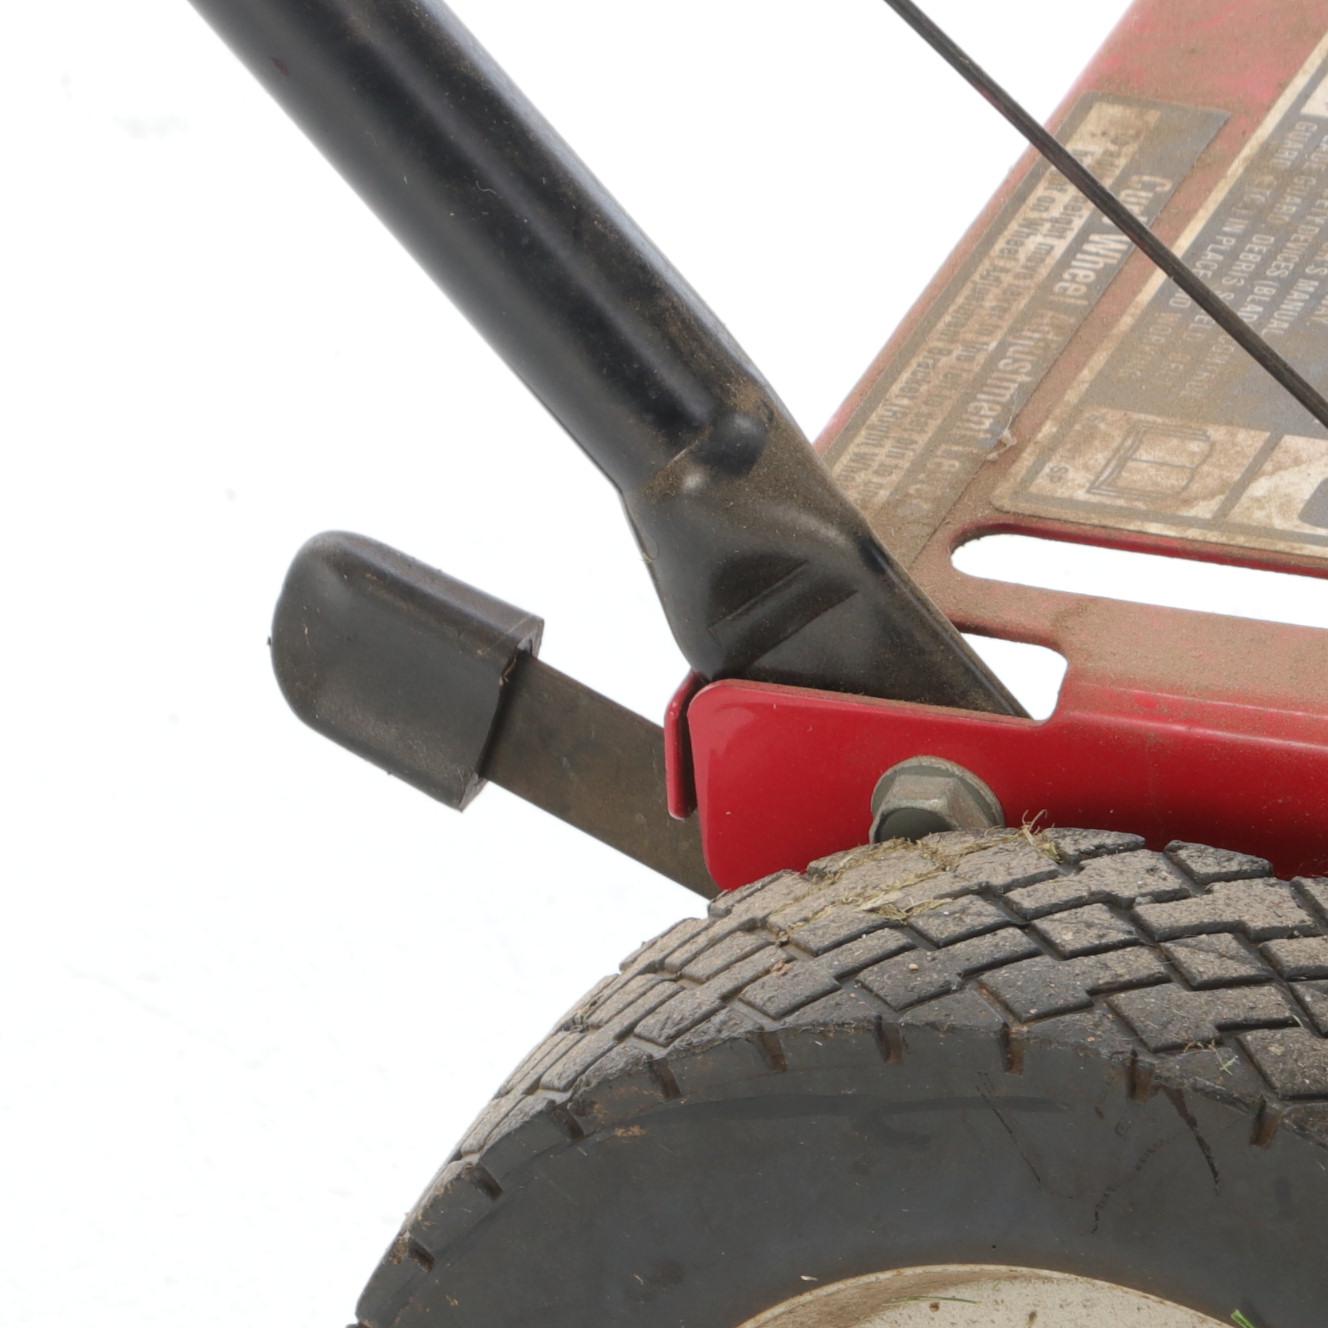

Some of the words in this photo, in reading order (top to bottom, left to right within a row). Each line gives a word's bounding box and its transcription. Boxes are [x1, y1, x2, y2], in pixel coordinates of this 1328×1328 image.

[1042, 231, 1136, 306] Wheel
[1217, 233, 1277, 286] DEBRIS
[1262, 224, 1321, 278] DEVICES
[940, 307, 1081, 439] Adjustment
